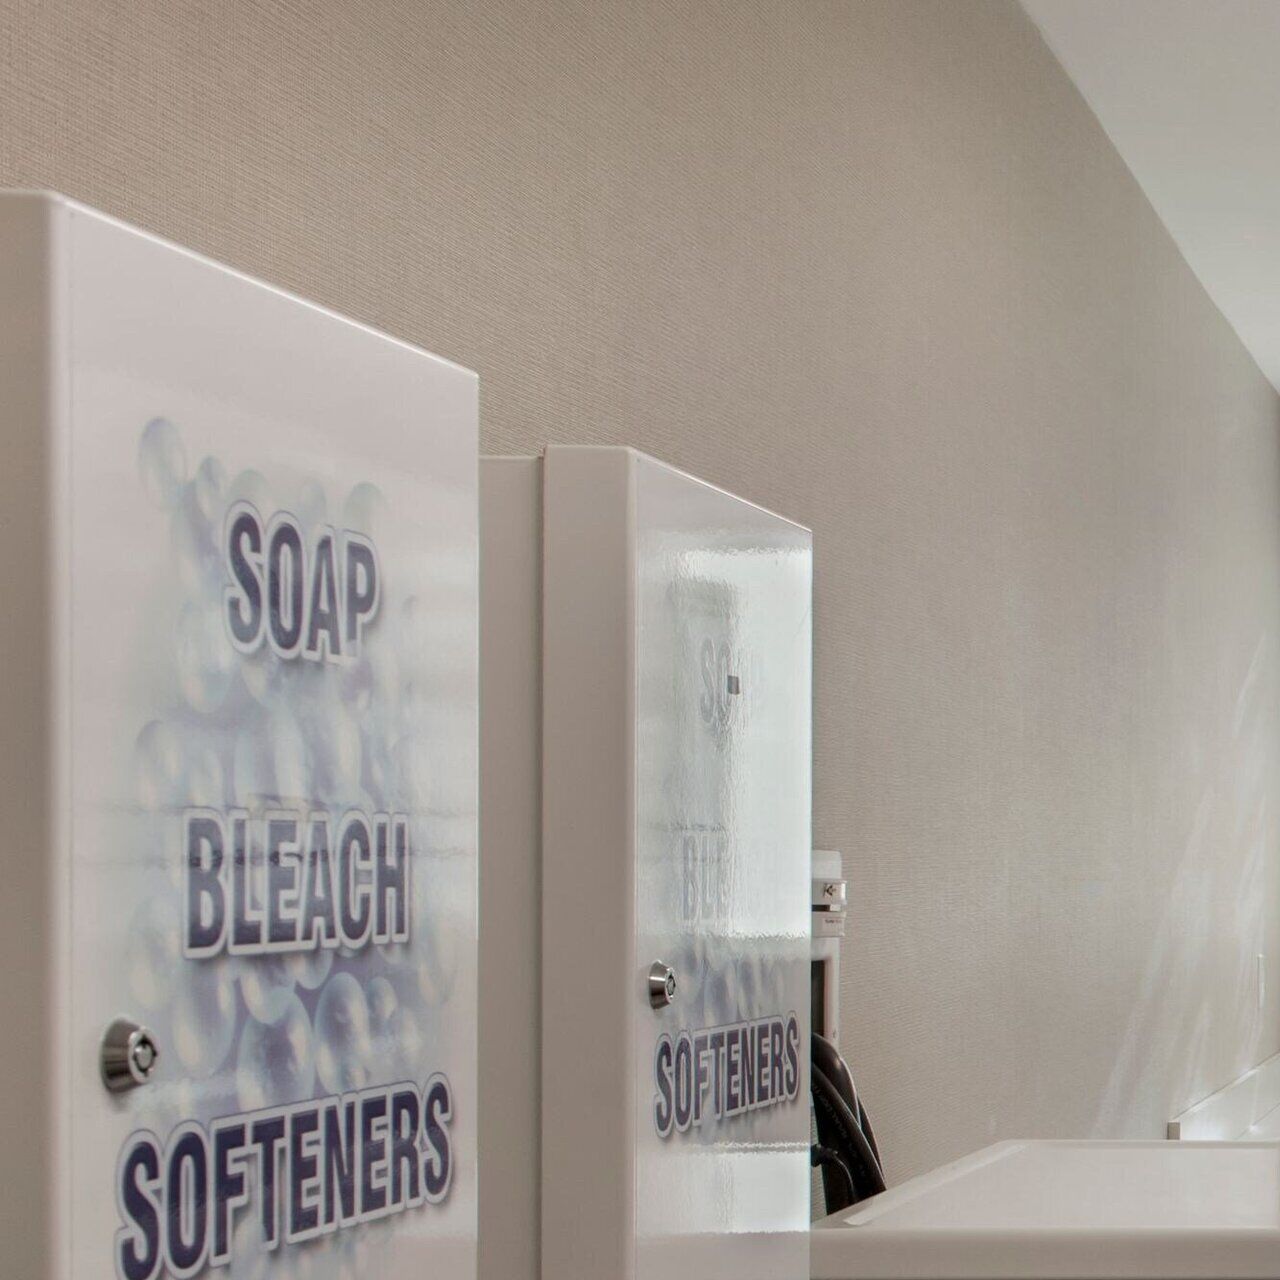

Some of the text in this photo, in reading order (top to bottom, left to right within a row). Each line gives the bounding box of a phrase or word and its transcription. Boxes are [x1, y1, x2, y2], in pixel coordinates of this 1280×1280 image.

[227, 507, 379, 661] SOAP
[184, 812, 410, 953] BLEACH
[655, 1014, 799, 1135] SOFTENERS
